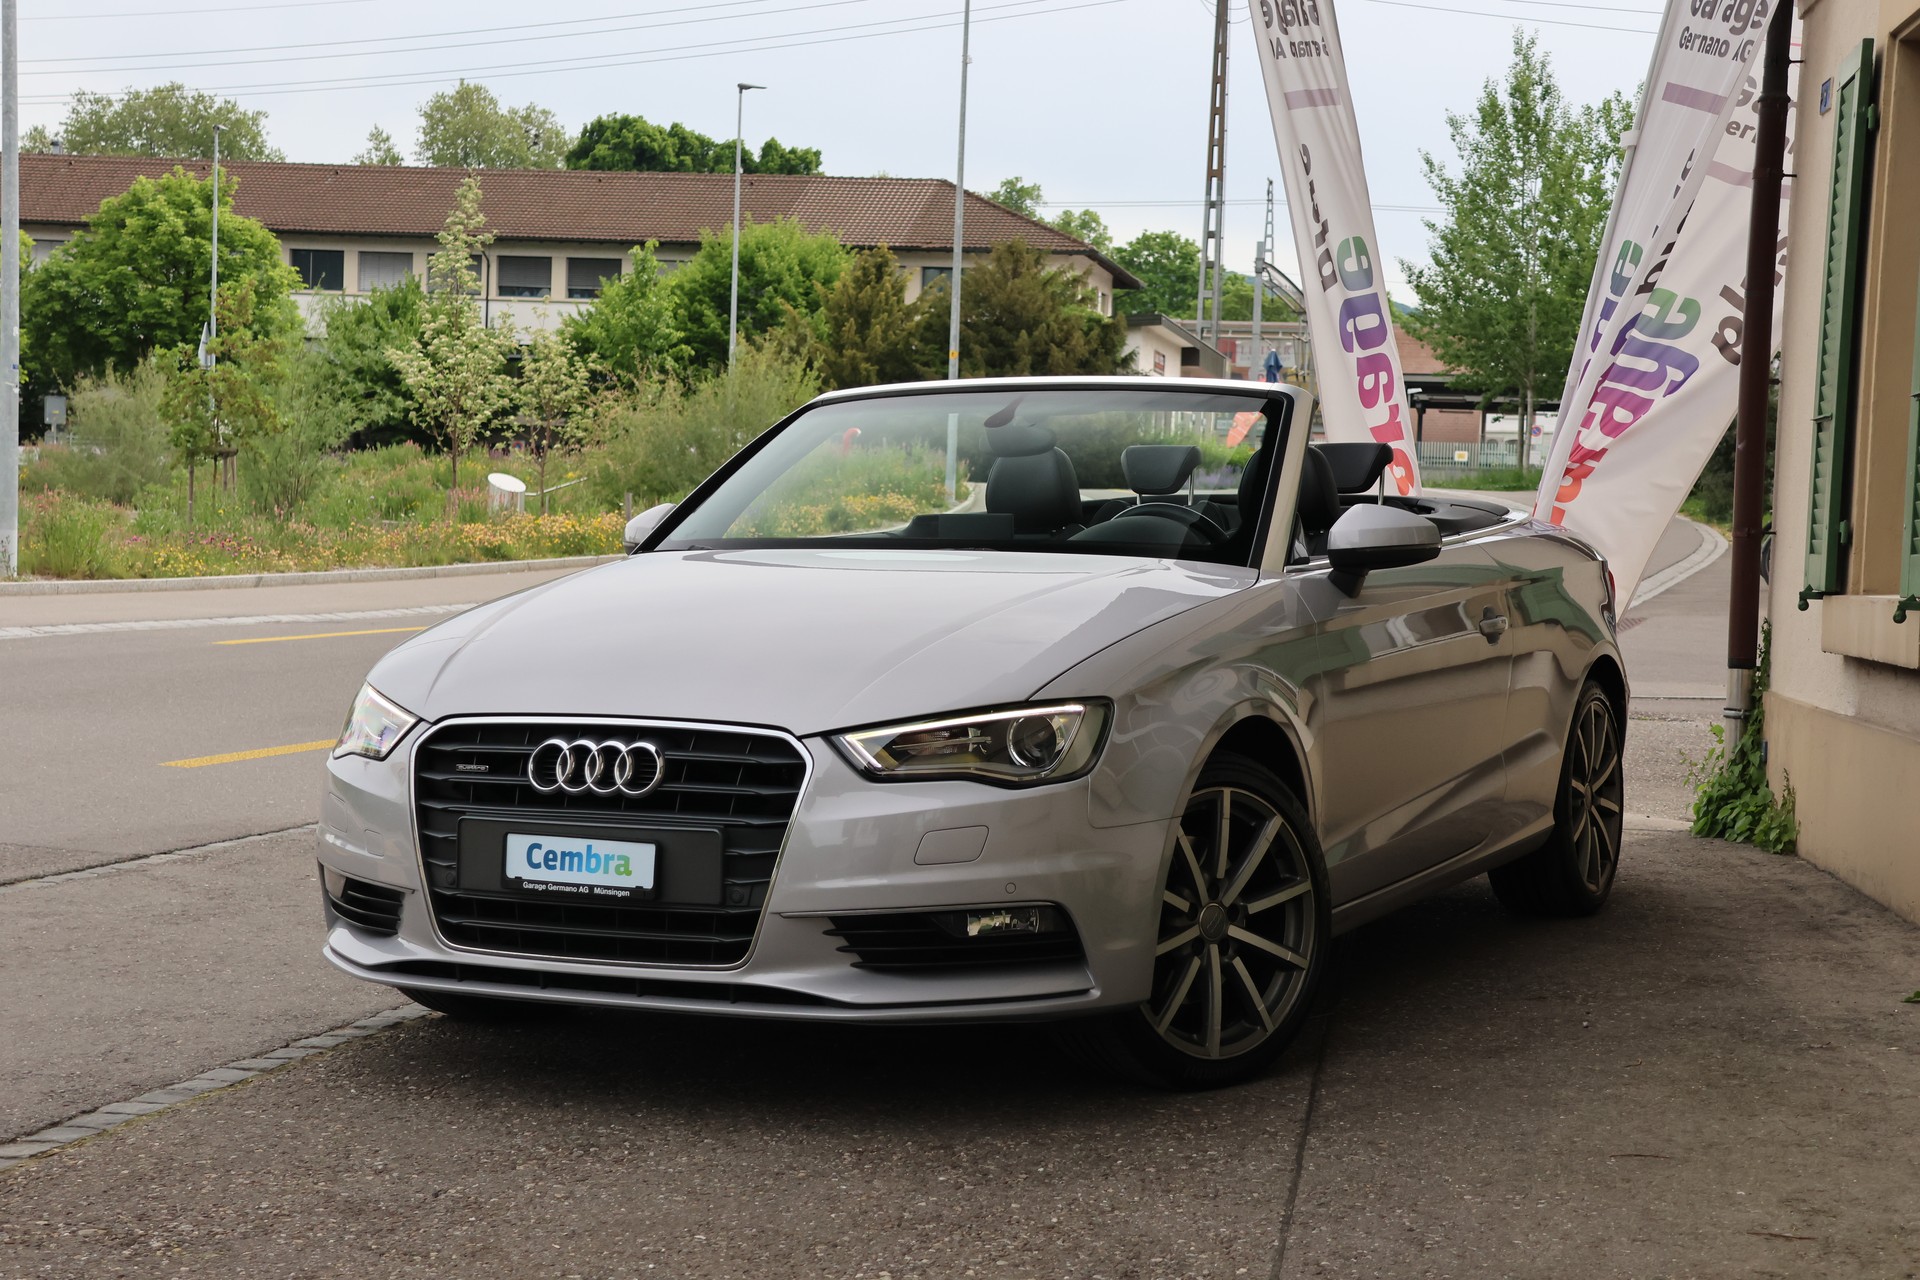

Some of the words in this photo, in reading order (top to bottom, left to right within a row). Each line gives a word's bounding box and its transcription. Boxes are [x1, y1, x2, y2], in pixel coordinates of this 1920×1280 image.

[526, 842, 632, 877] Cembra
[523, 881, 547, 891] Garage
[547, 883, 578, 893] Germano
[594, 887, 630, 898] Münsingen
